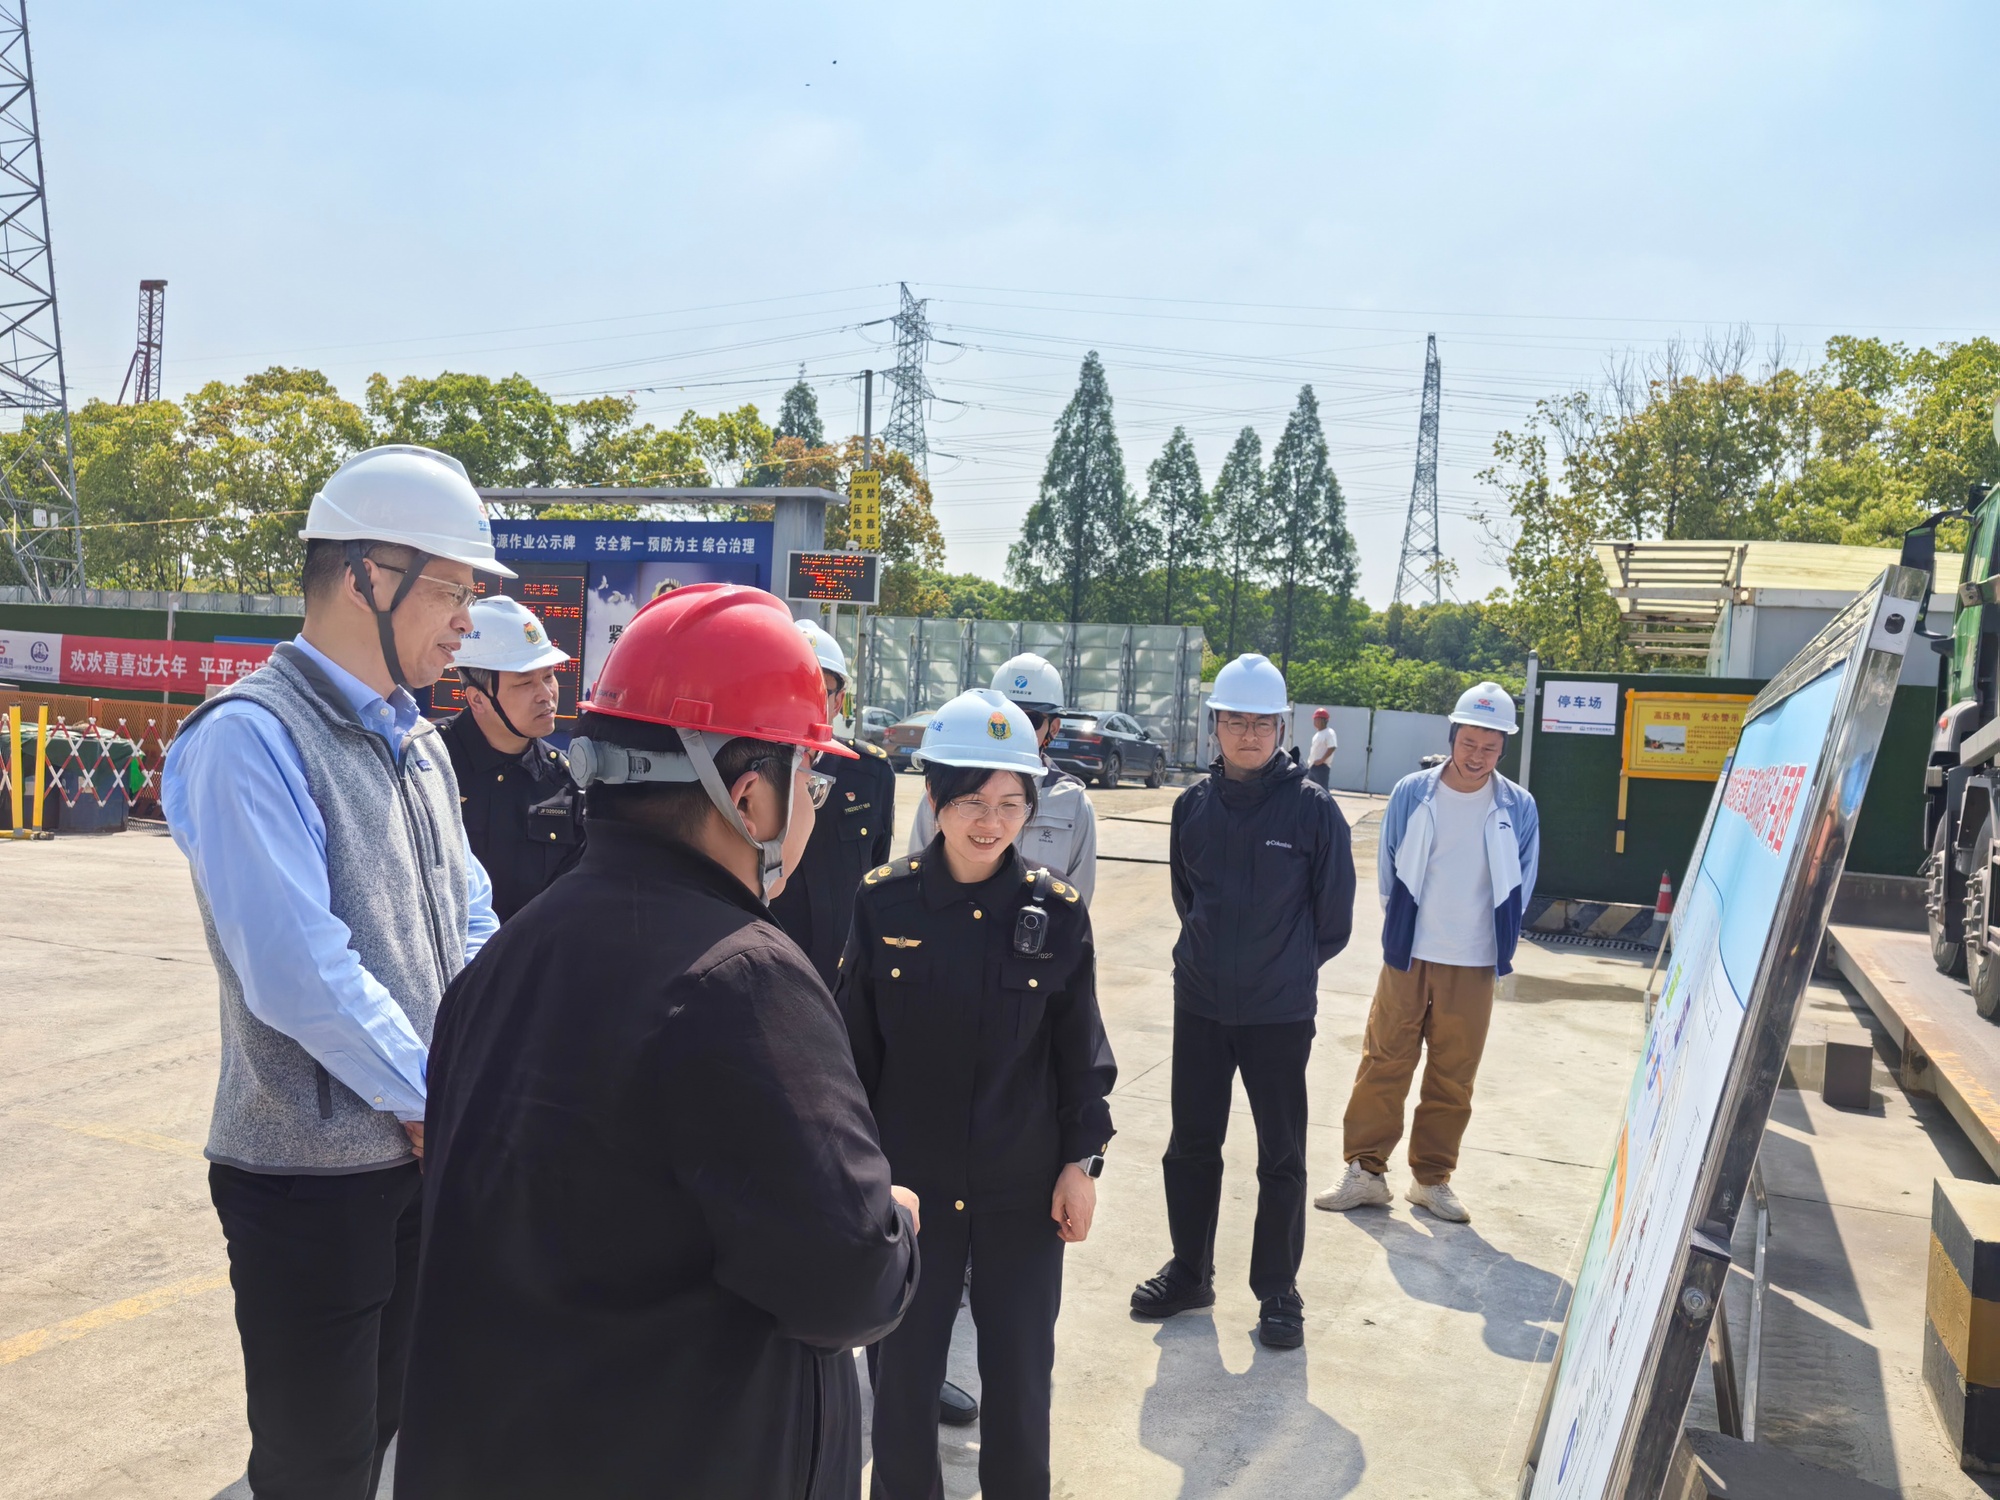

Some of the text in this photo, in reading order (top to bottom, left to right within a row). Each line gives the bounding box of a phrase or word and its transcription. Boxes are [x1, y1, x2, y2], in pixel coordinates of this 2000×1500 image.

[853, 475, 876, 485] 220KV
[491, 533, 576, 550] 源作业公示牌
[595, 535, 755, 554] 安全第一 预防为主 综合治理
[70, 649, 188, 679] 欢欢喜喜过大年
[1557, 695, 1602, 709] 停车场
